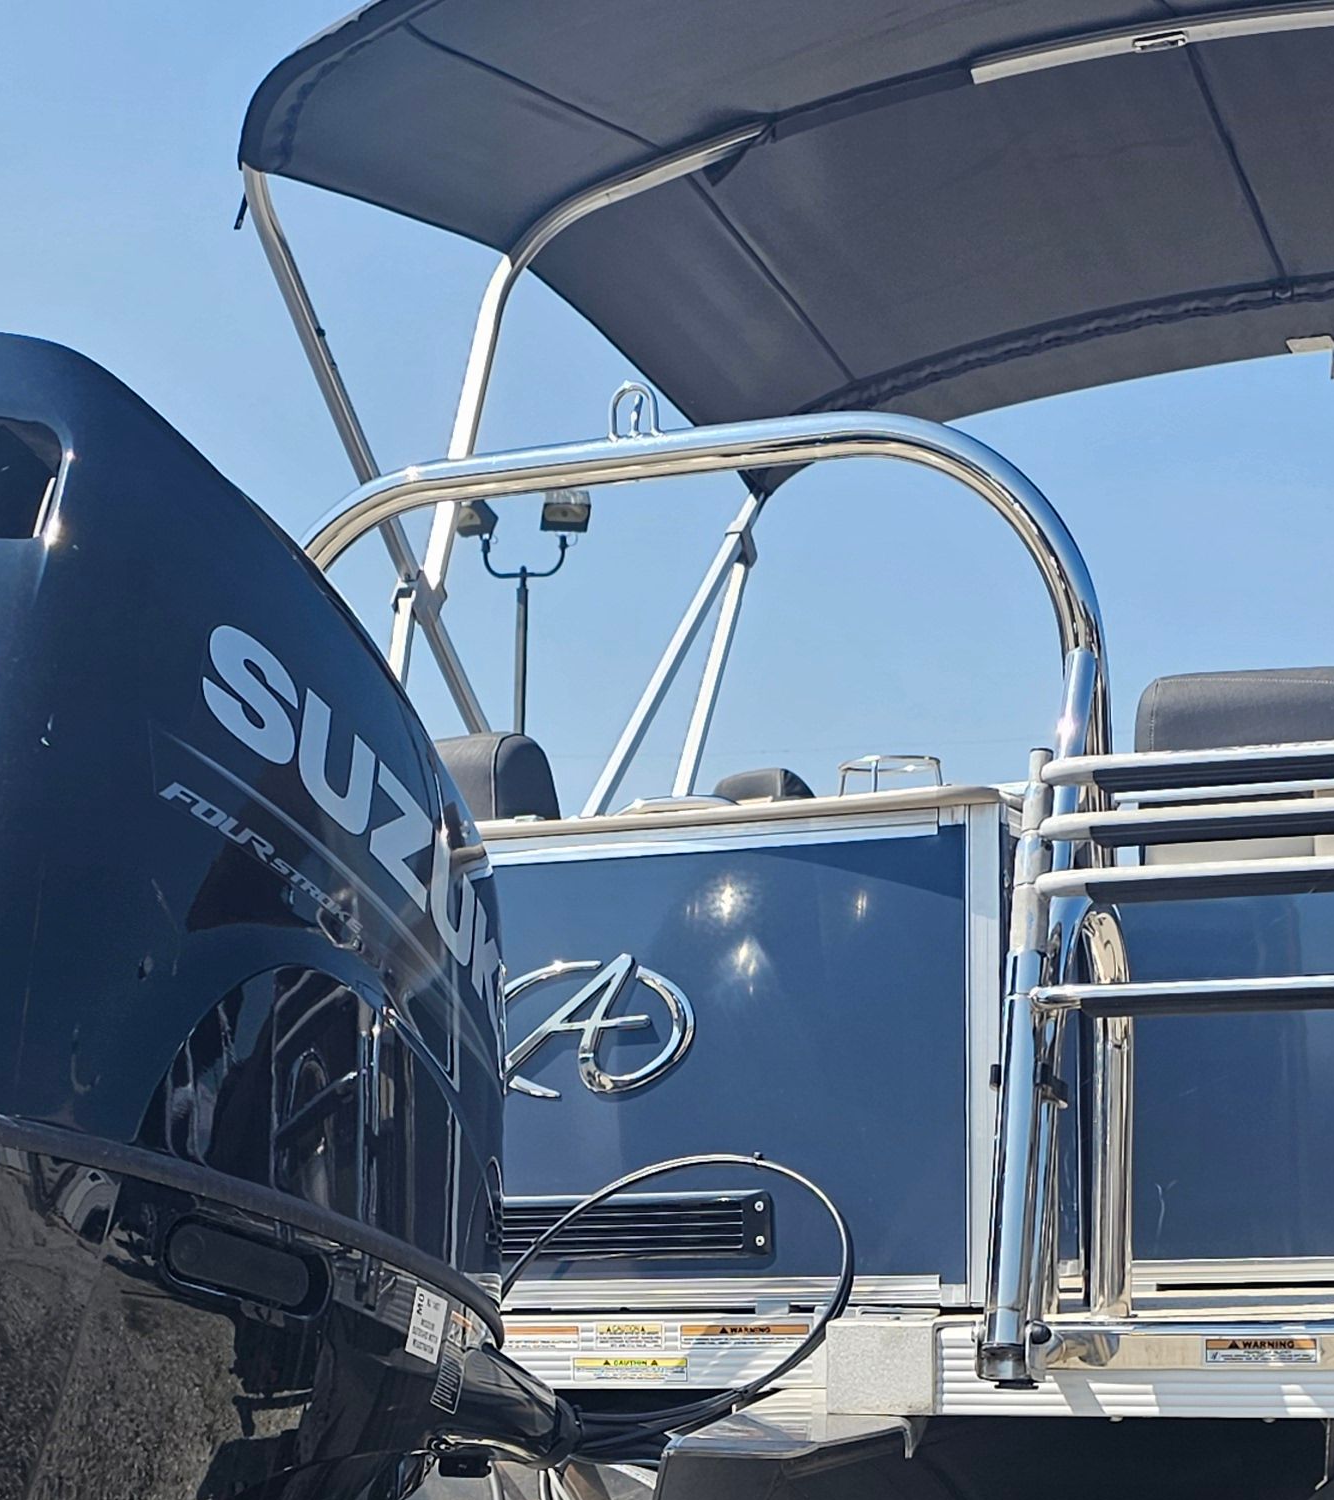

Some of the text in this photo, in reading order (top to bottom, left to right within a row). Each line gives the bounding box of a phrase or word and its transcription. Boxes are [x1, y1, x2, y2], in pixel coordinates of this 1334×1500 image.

[202, 624, 503, 1058] SUZUK
[159, 782, 364, 935] FOUR STROKE
[730, 1326, 771, 1334] WARNING
[1242, 1340, 1295, 1349] WARNING
[613, 1359, 647, 1367] CAUTION
